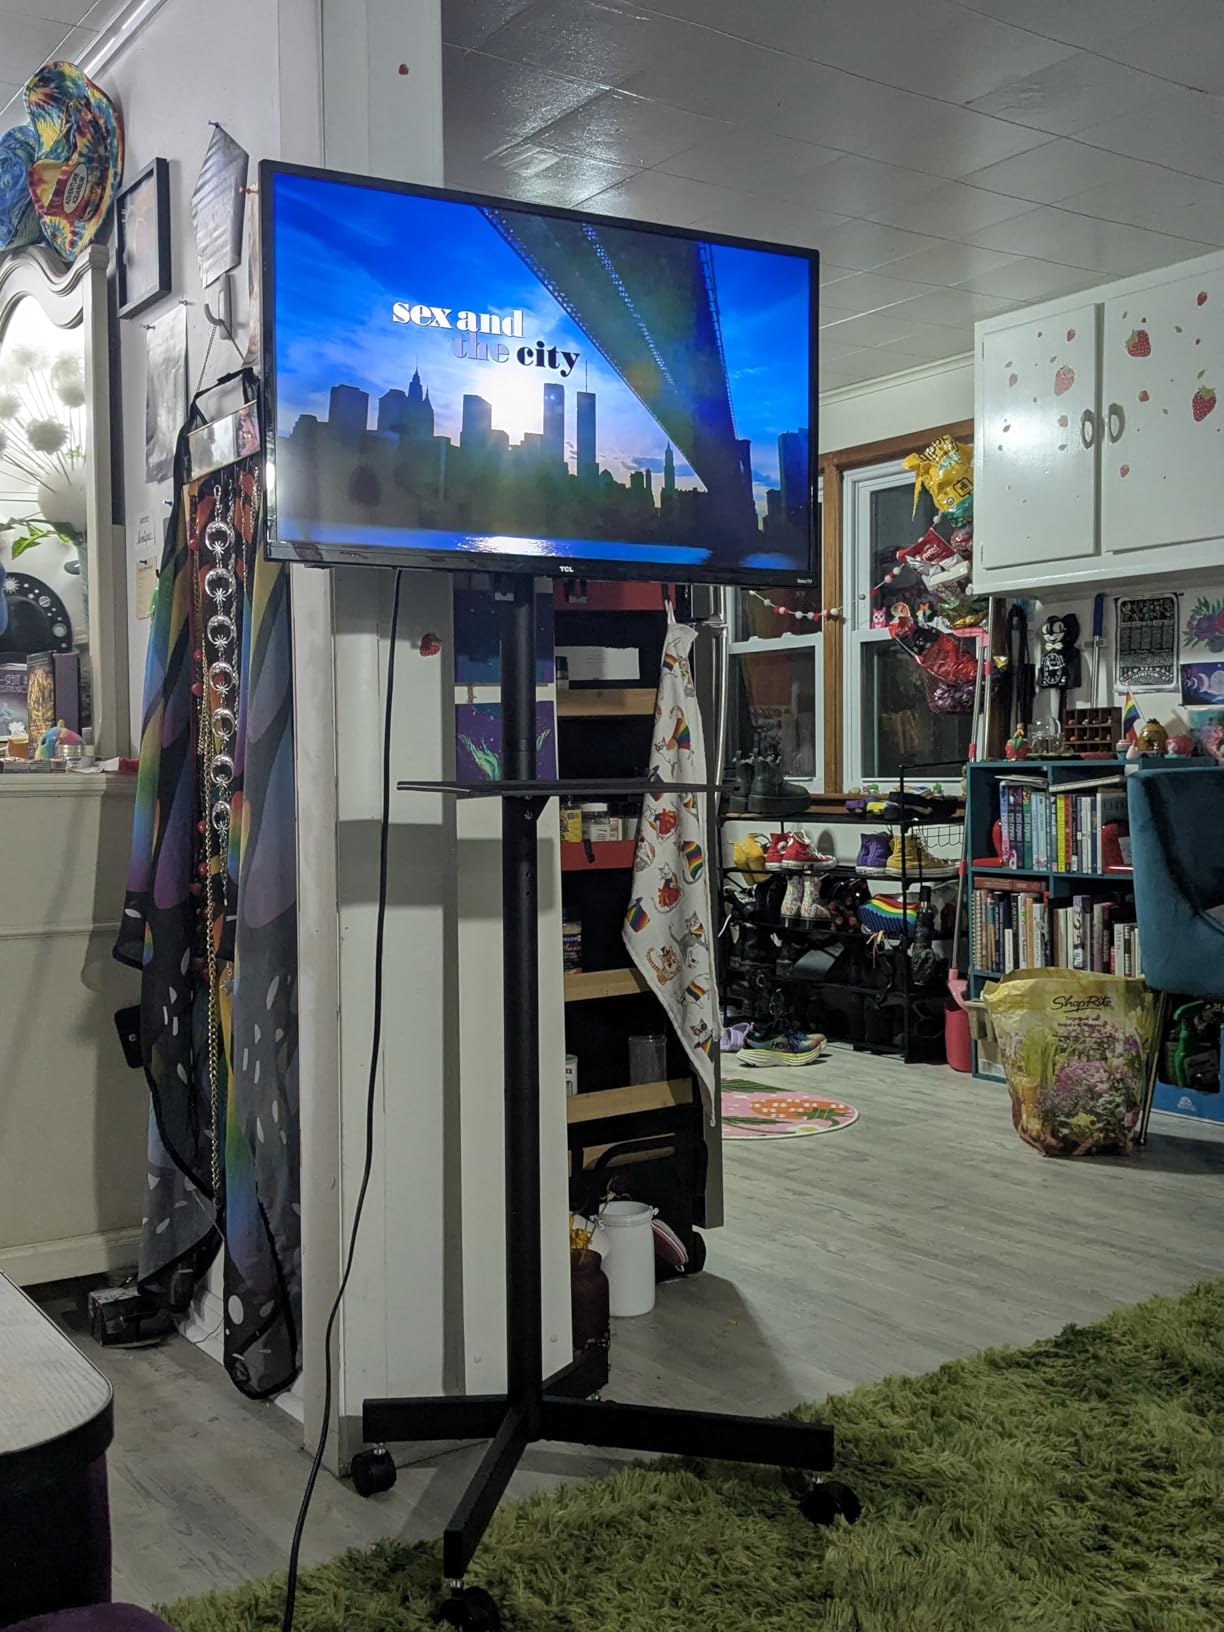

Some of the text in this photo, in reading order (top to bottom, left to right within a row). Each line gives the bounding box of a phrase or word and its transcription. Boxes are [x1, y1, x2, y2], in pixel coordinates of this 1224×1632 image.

[65, 172, 79, 205] ADVENTURE
[72, 176, 85, 204] AQUARIUM
[392, 301, 526, 338] sex and
[453, 332, 581, 378] the city
[559, 565, 574, 573] TCL
[1050, 995, 1112, 1013] ShopRite
